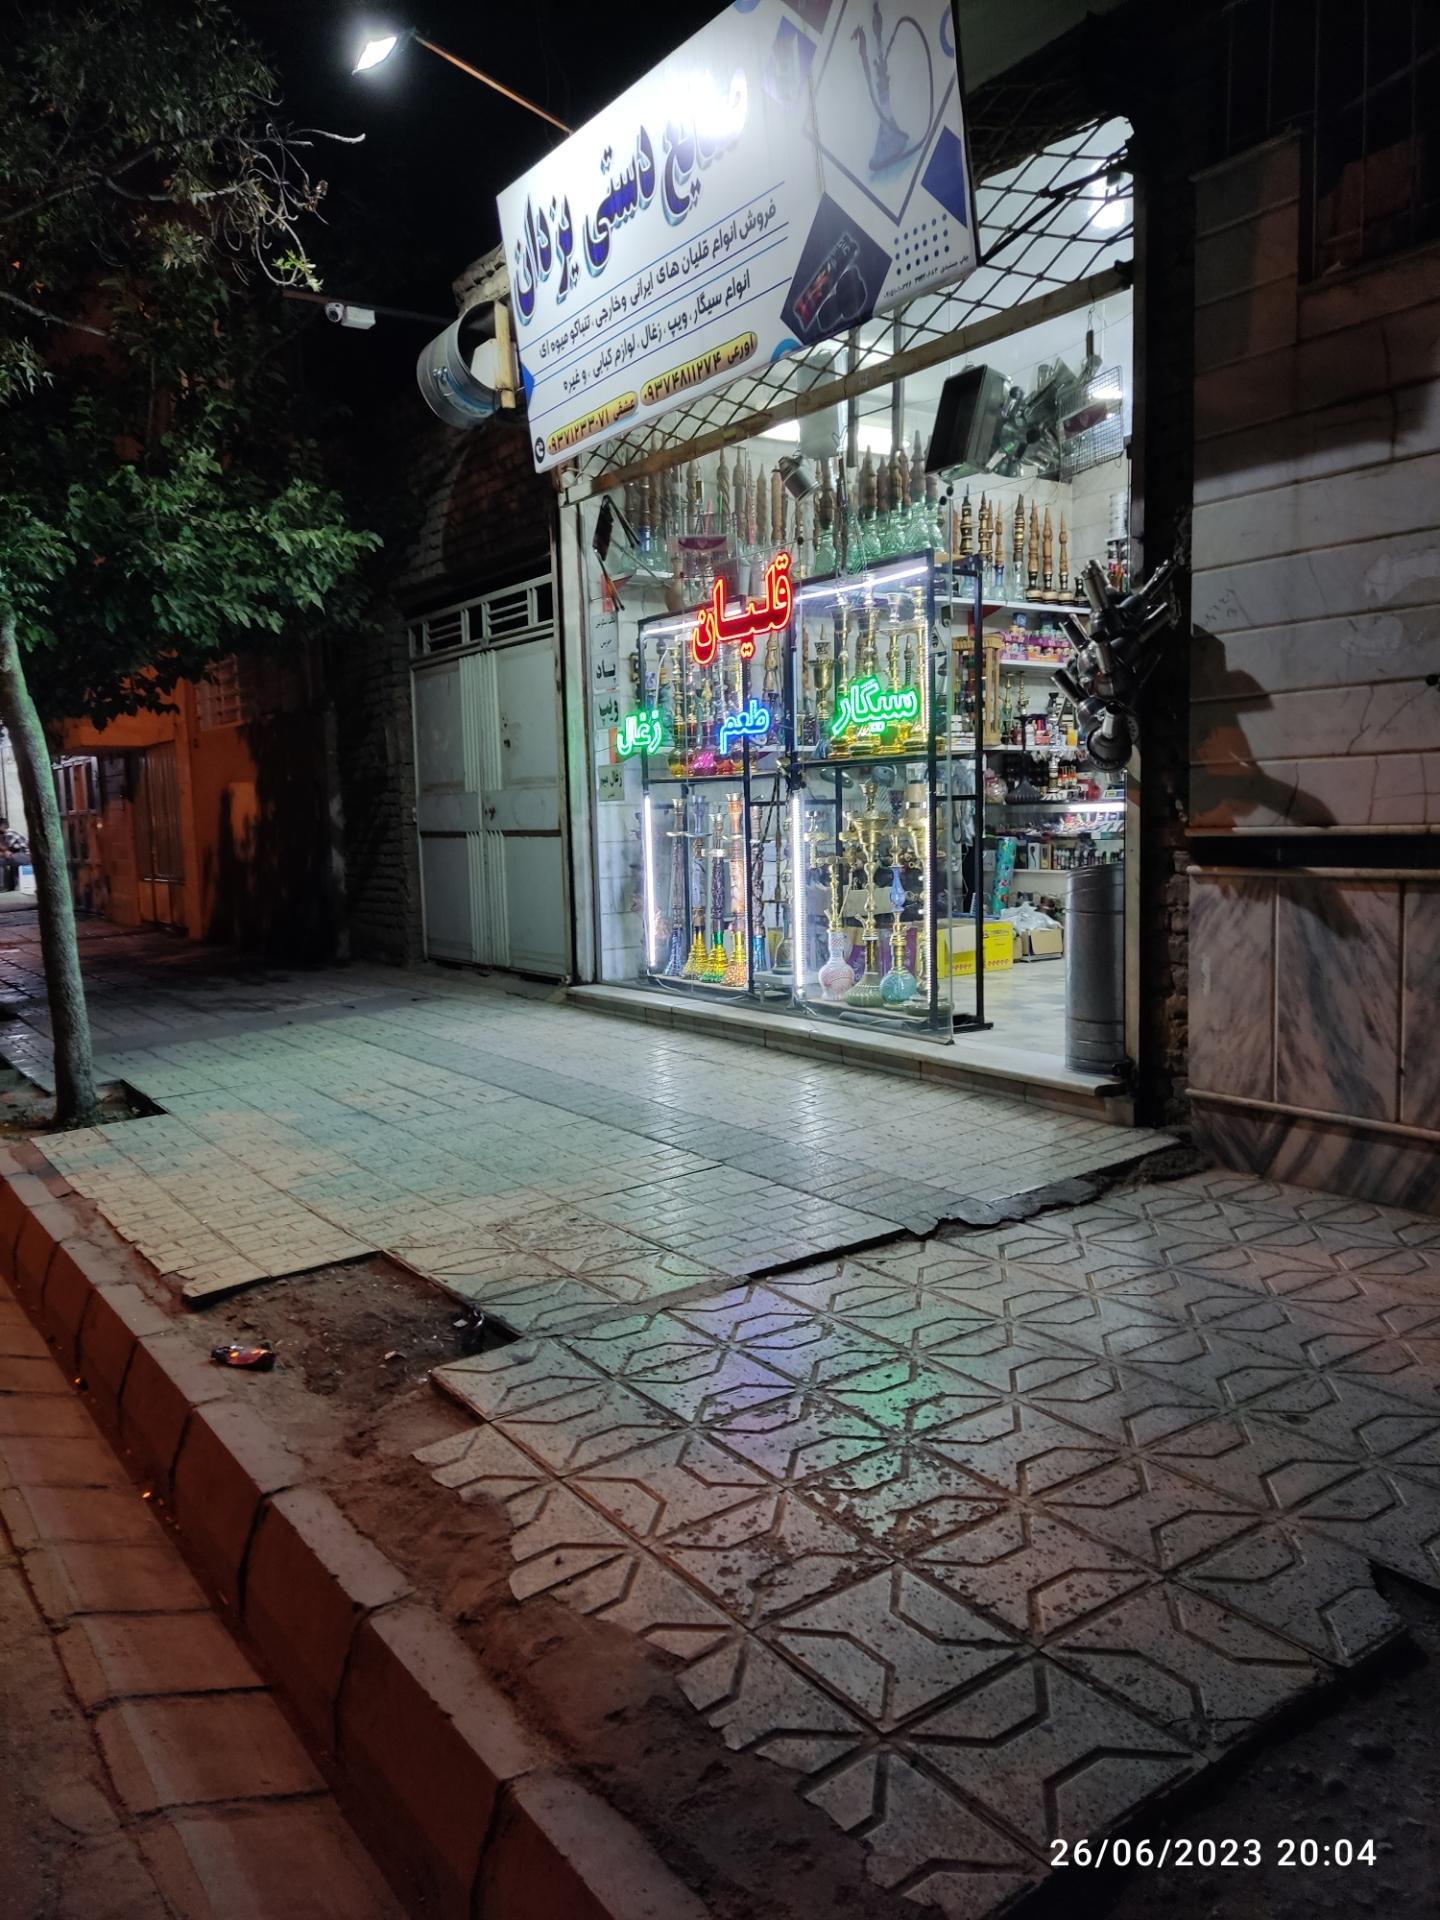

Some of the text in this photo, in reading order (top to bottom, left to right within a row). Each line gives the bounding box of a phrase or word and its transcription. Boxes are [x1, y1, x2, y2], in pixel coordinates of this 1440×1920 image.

[583, 123, 656, 277] دستی
[739, 198, 776, 240] فروش
[514, 192, 579, 325] یزدان
[681, 240, 709, 275] قلیان
[712, 220, 738, 259] انواع
[630, 271, 654, 306] ایرانی
[656, 261, 680, 284] های
[725, 268, 750, 307] انواع
[667, 311, 688, 338] ویپ
[694, 290, 722, 324] سیگار
[569, 314, 591, 345] تنباکو
[640, 322, 663, 350] زغال
[614, 332, 635, 367] لوازم
[691, 552, 793, 665] قلیان
[831, 678, 917, 736] سیگار
[616, 708, 662, 756] زغال
[719, 700, 770, 754] طعم
